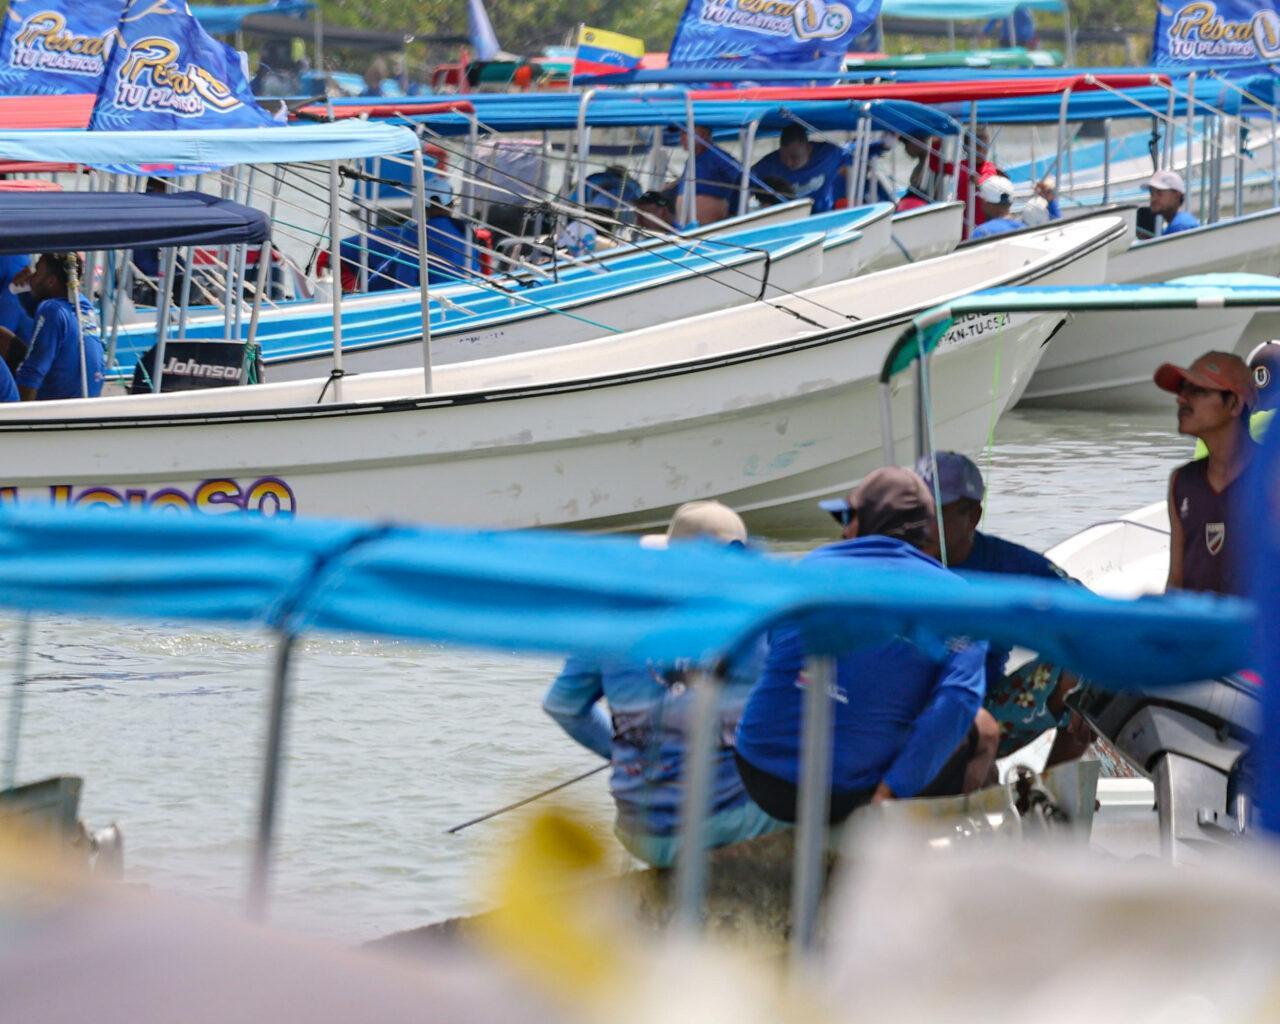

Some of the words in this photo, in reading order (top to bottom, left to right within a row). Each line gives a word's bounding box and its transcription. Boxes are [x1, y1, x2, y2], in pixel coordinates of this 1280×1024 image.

[704, 6, 727, 23] TU
[1173, 39, 1192, 56] TU
[13, 48, 35, 67] TU
[118, 82, 144, 107] TU
